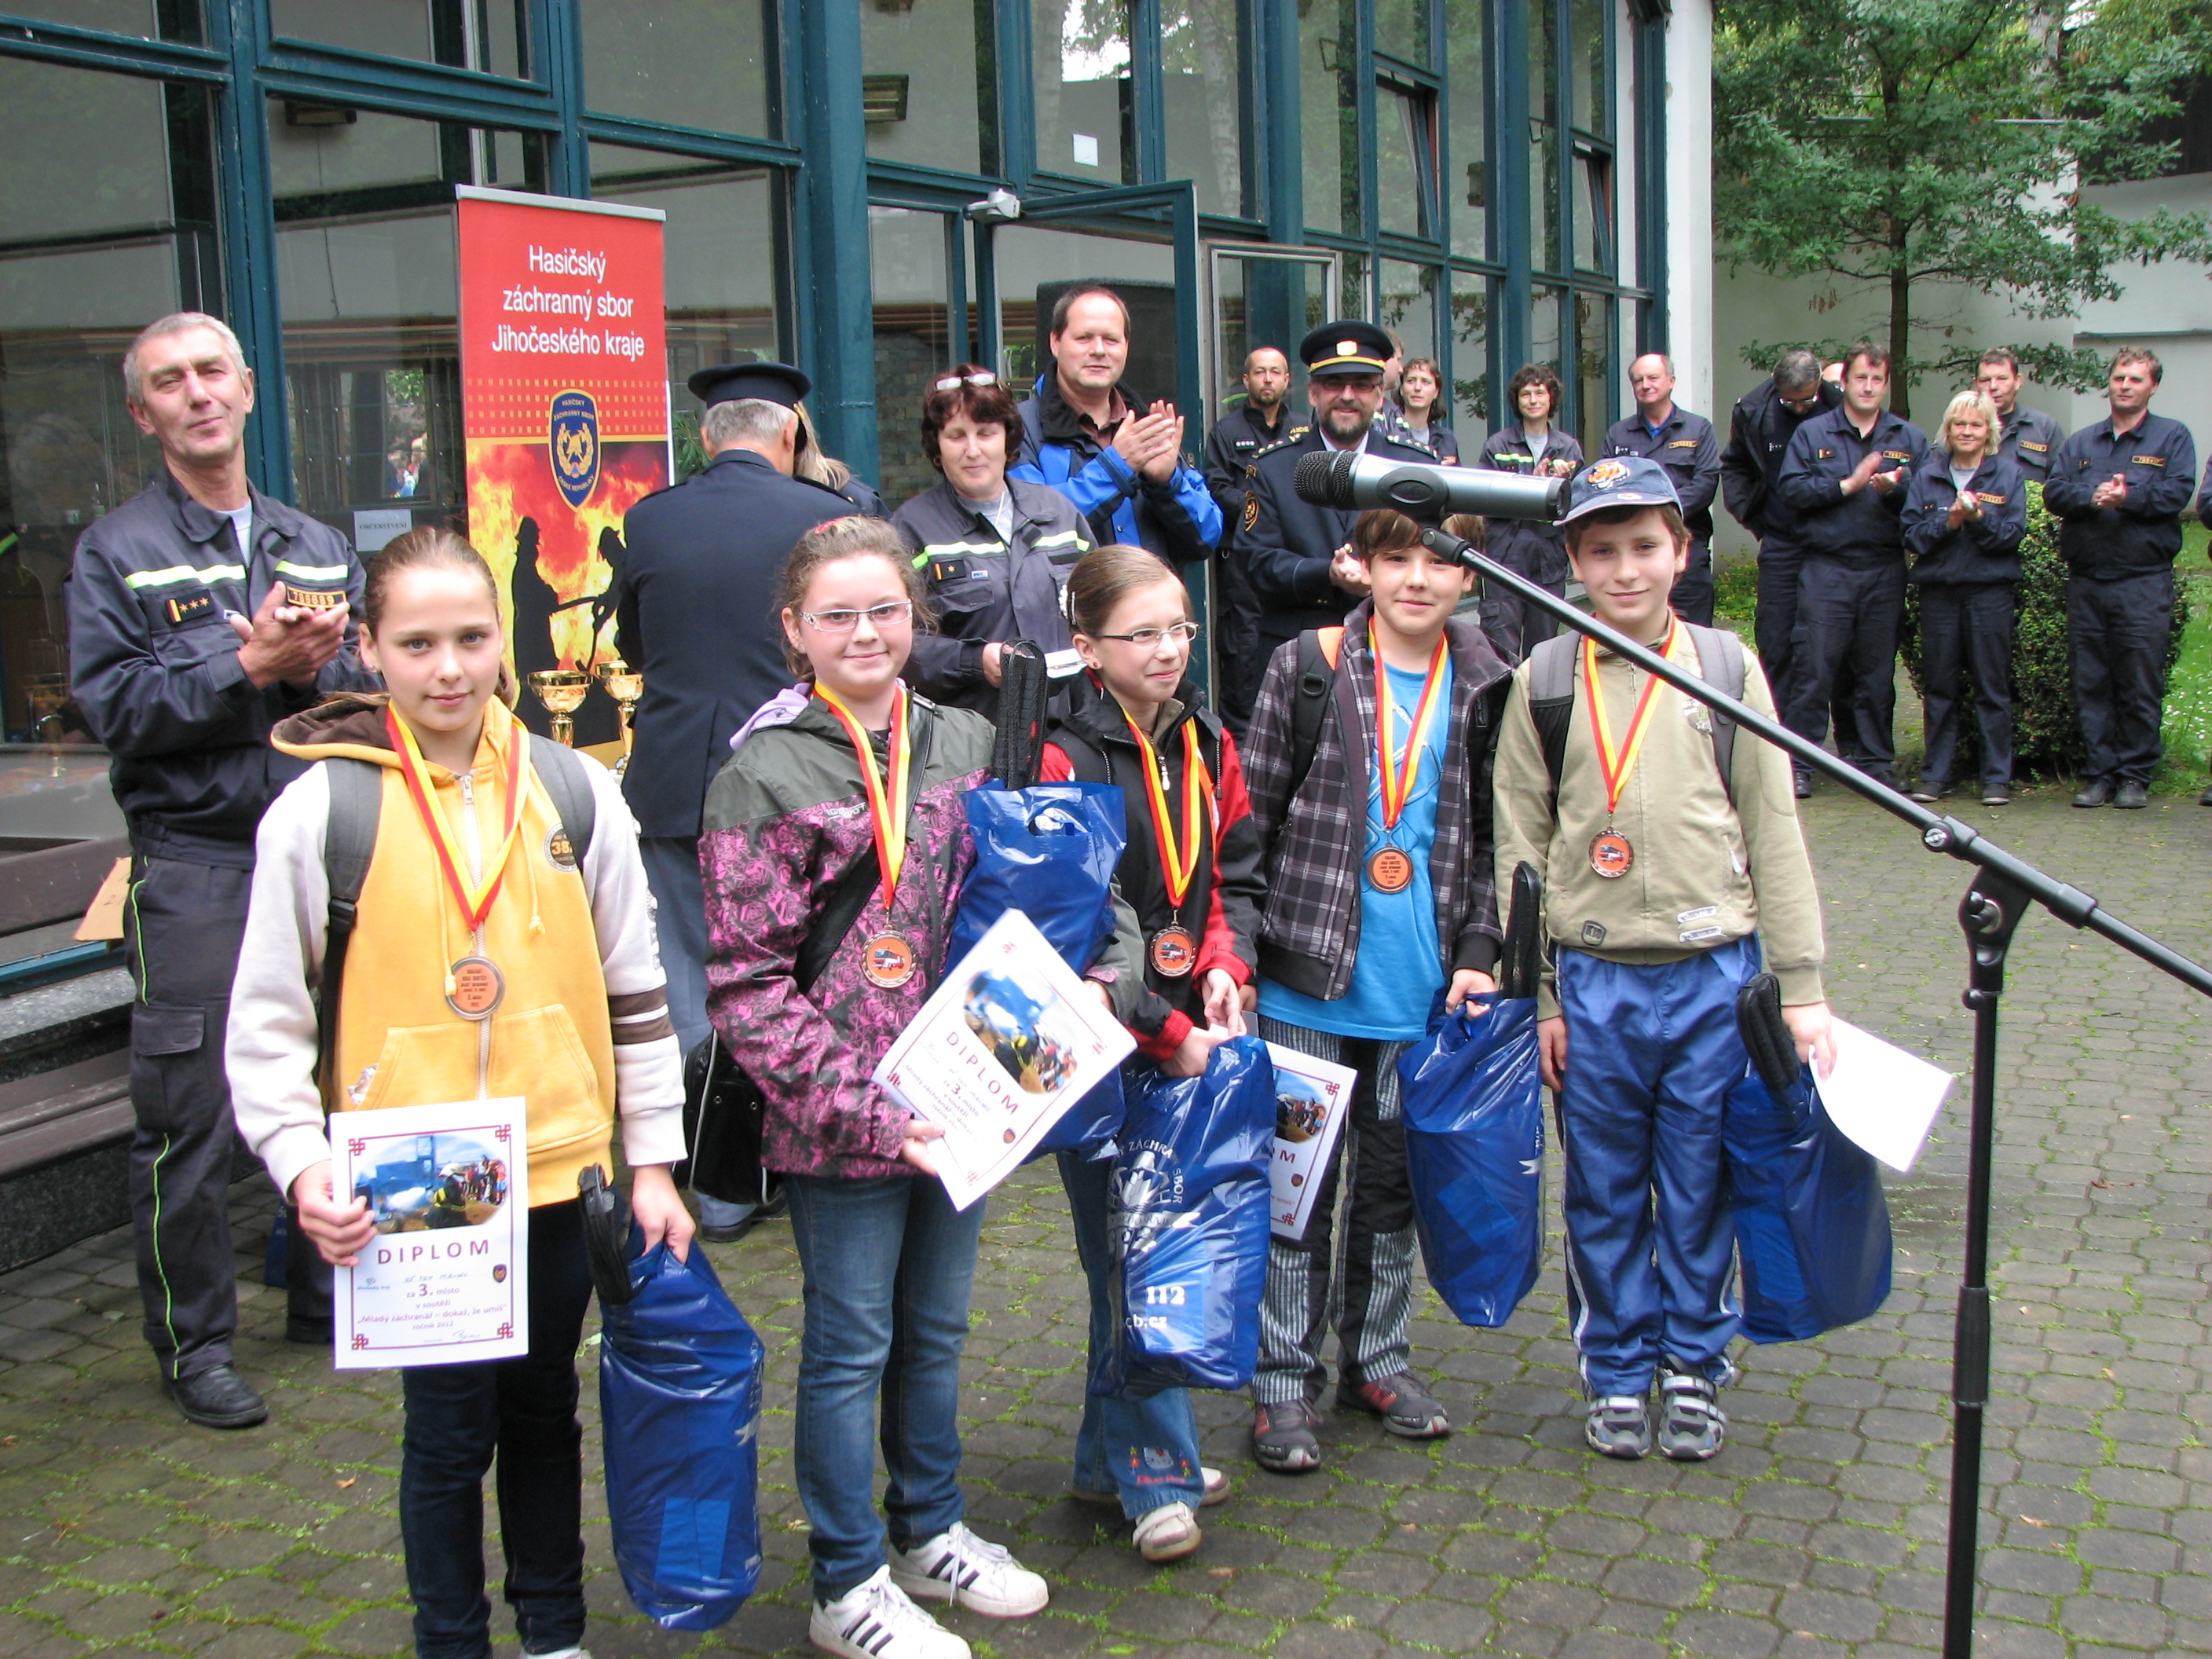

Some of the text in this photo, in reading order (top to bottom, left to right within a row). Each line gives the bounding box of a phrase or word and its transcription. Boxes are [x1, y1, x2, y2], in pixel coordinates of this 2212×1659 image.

[529, 244, 606, 284] Hasičský
[503, 284, 634, 322] záchranný sbor
[492, 324, 645, 361] Jihočeského kraje
[947, 1031, 1019, 1115] DIPLOM
[1173, 1168, 1184, 1204] SBOR
[377, 1240, 489, 1264] DIPLOM
[1147, 1285, 1185, 1305] 112
